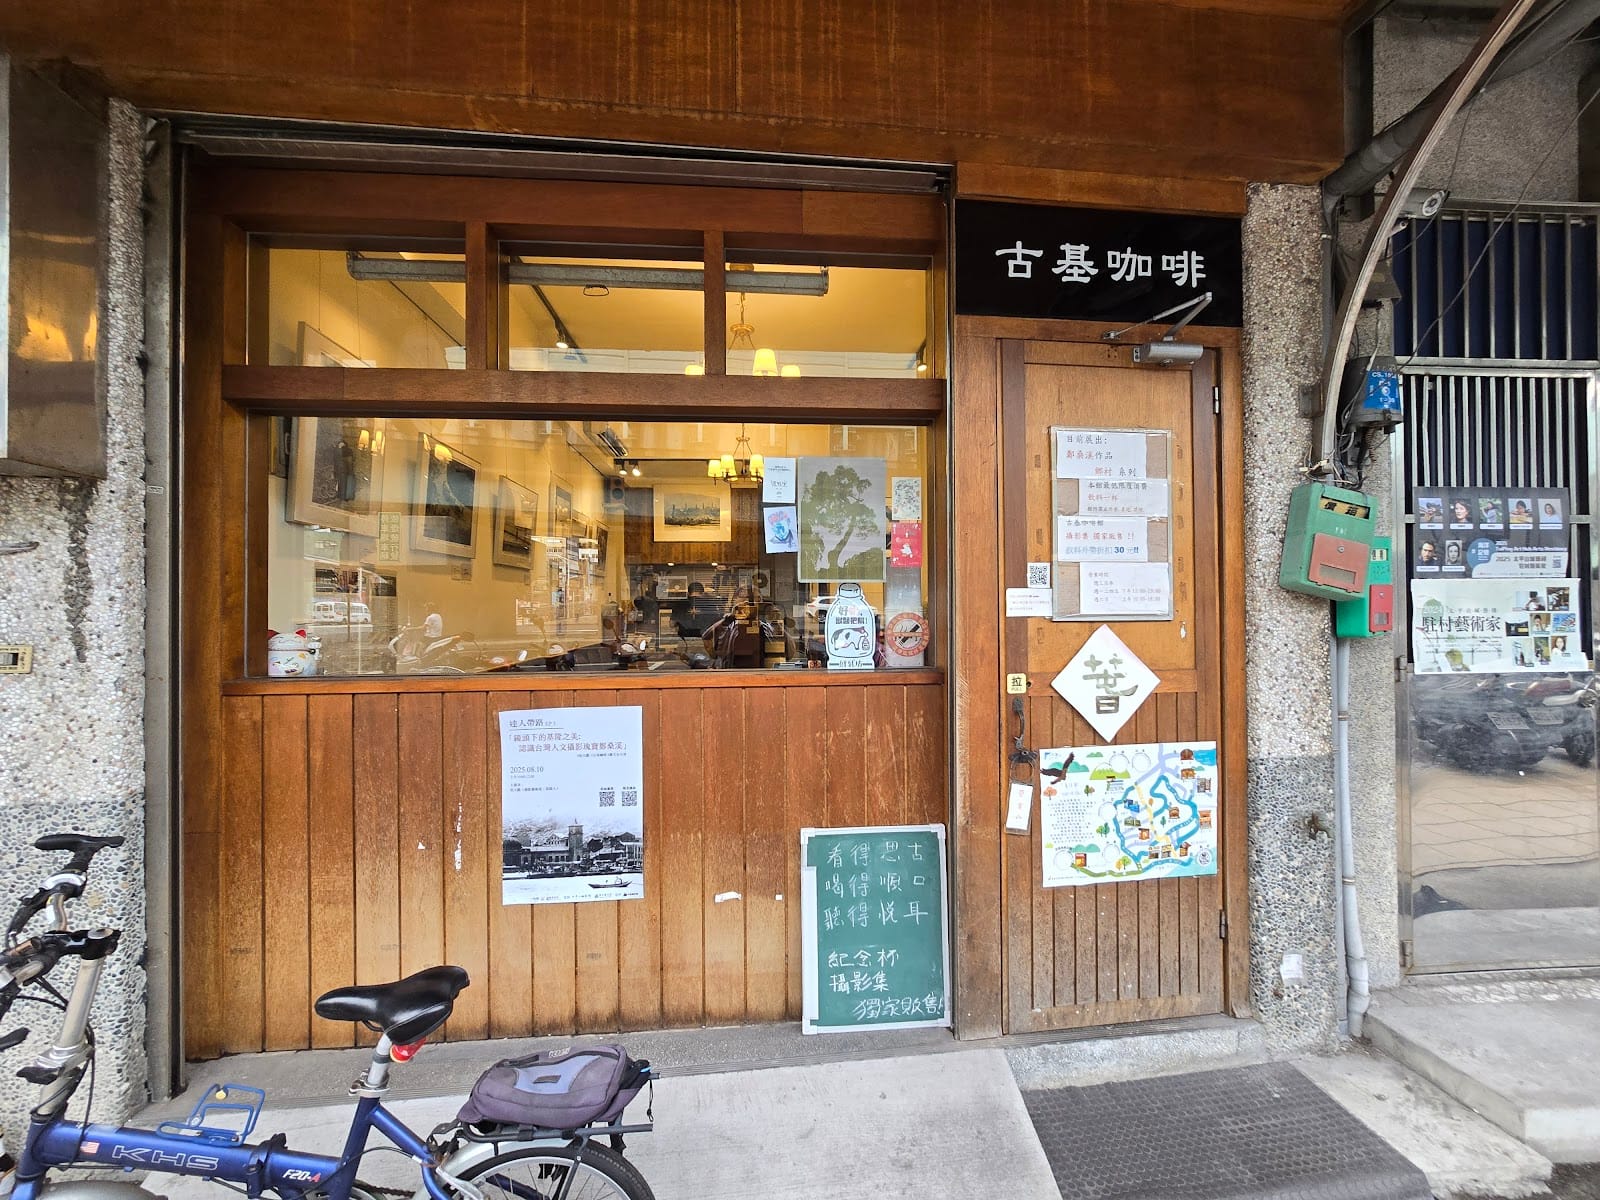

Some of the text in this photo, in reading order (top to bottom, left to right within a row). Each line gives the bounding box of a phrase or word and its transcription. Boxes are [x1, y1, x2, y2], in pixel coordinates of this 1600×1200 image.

[995, 241, 1207, 288] 古基咖啡
[1114, 546, 1125, 554] 30
[1422, 615, 1501, 633] 駐村藝術家
[1011, 675, 1022, 687] 拉
[509, 766, 544, 774] 2025.08.10
[827, 840, 923, 868] 看得思古
[827, 949, 900, 968] 紀念杯
[829, 970, 890, 995] 攝影集
[112, 1144, 219, 1171] KHS
[281, 1167, 321, 1183] F20-A
